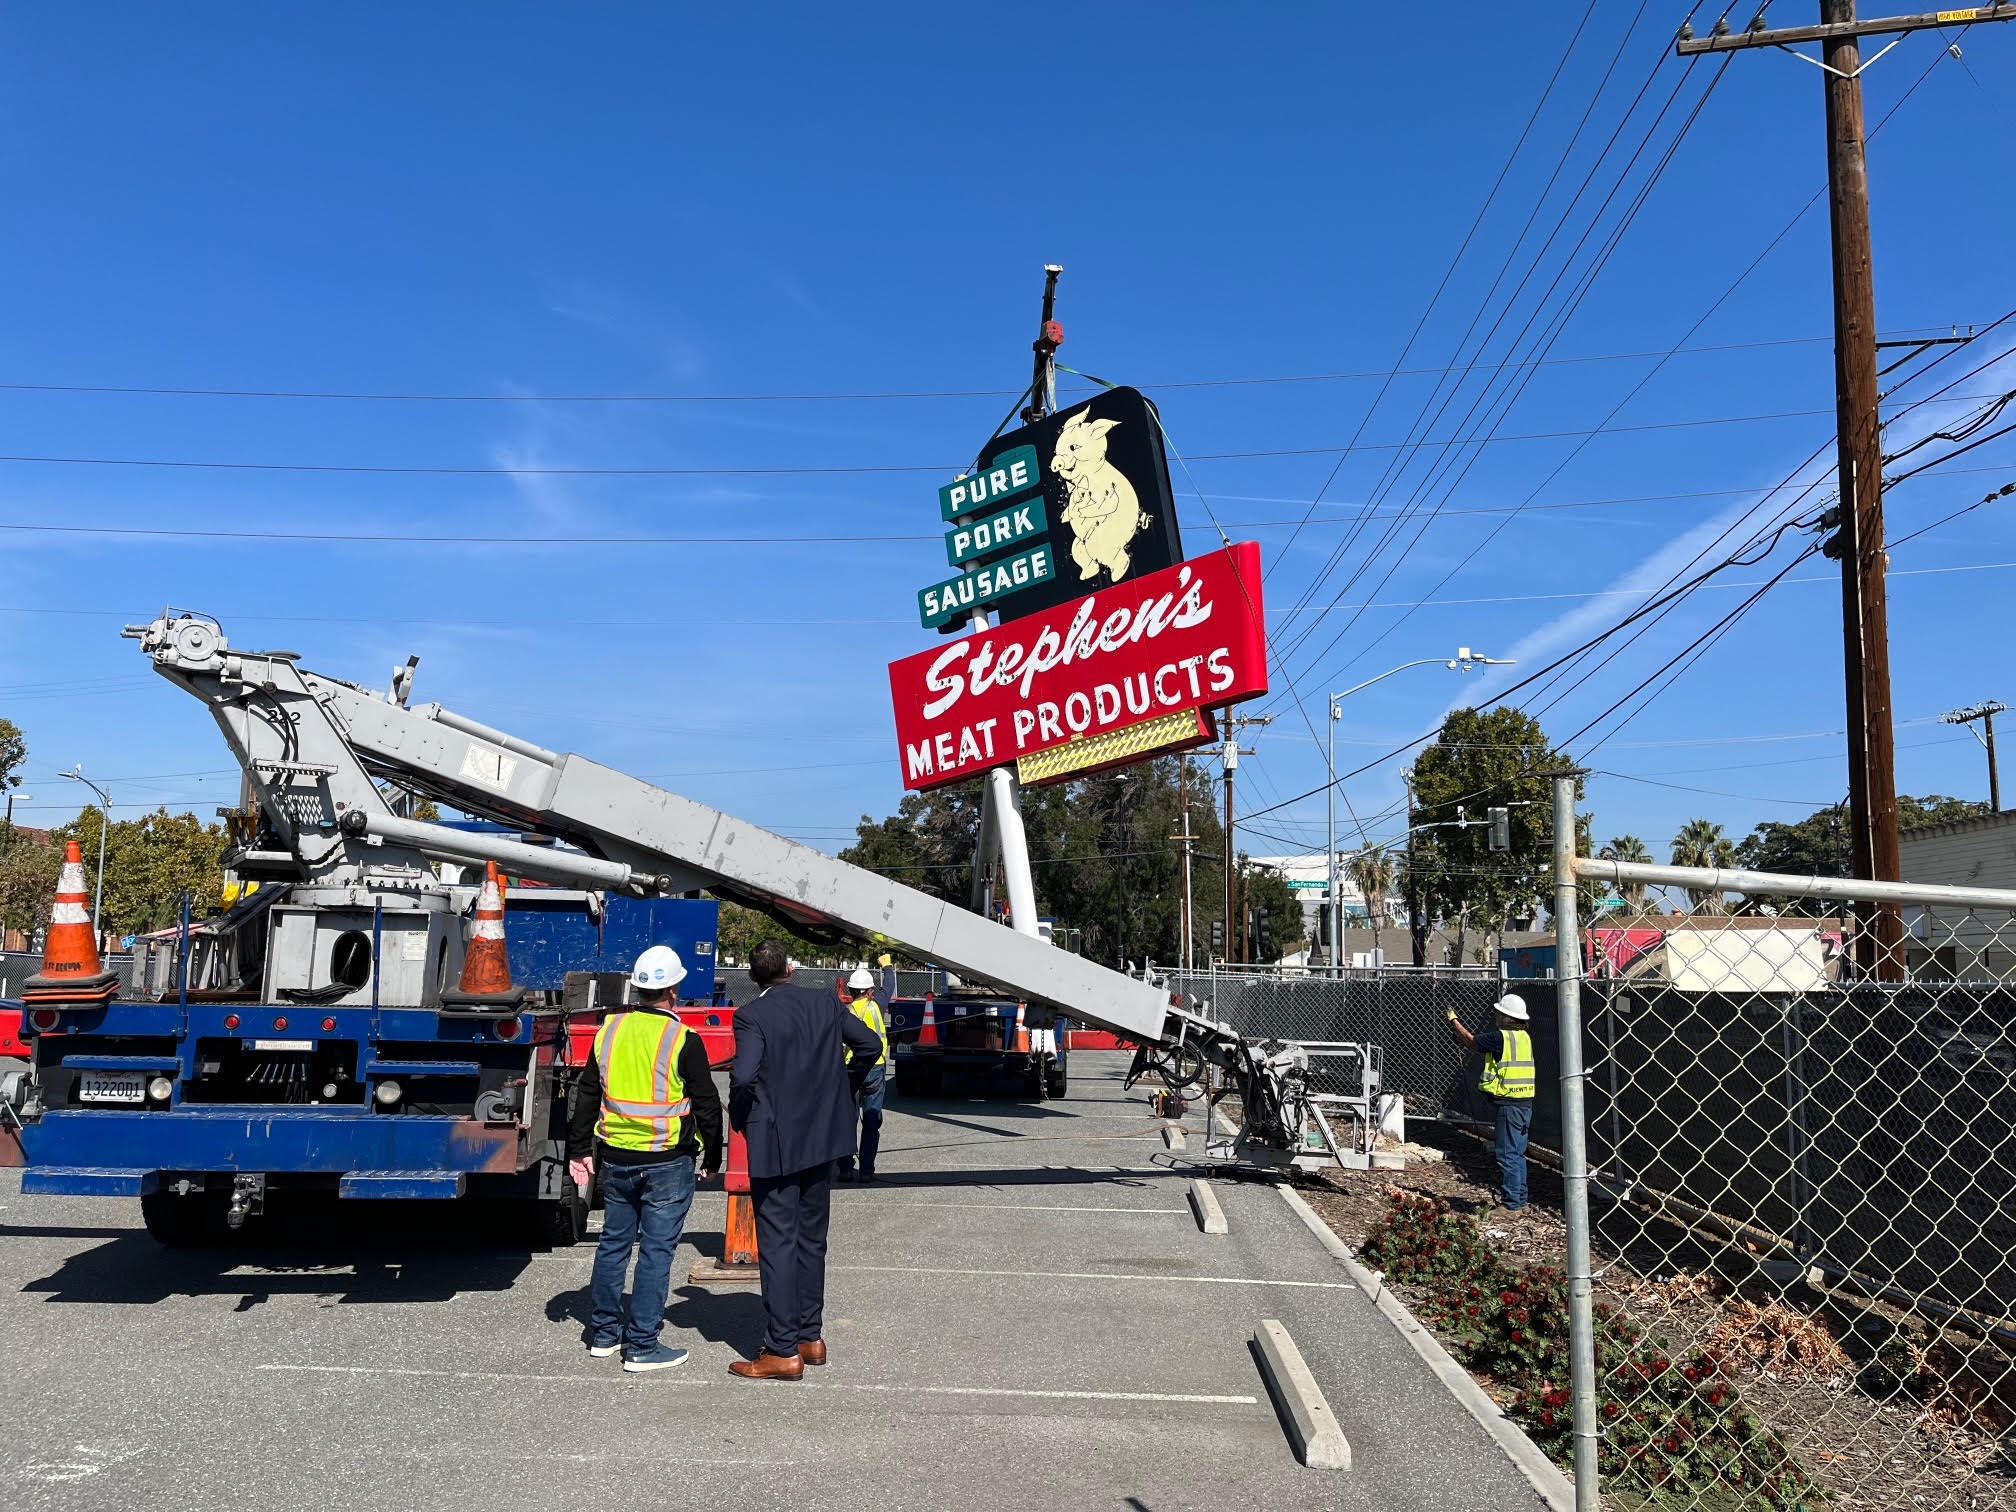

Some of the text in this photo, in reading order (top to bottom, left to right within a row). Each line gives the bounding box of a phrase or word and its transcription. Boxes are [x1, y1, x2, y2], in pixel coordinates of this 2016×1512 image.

[949, 460, 1028, 512] PURE
[953, 507, 1035, 558] PORK
[924, 550, 1047, 617] SAUSAGE
[923, 565, 1213, 720] Stephen's
[266, 709, 301, 726] 22
[906, 647, 1235, 780] MEAT PRODUCTS
[84, 1080, 141, 1097] 13220D1
